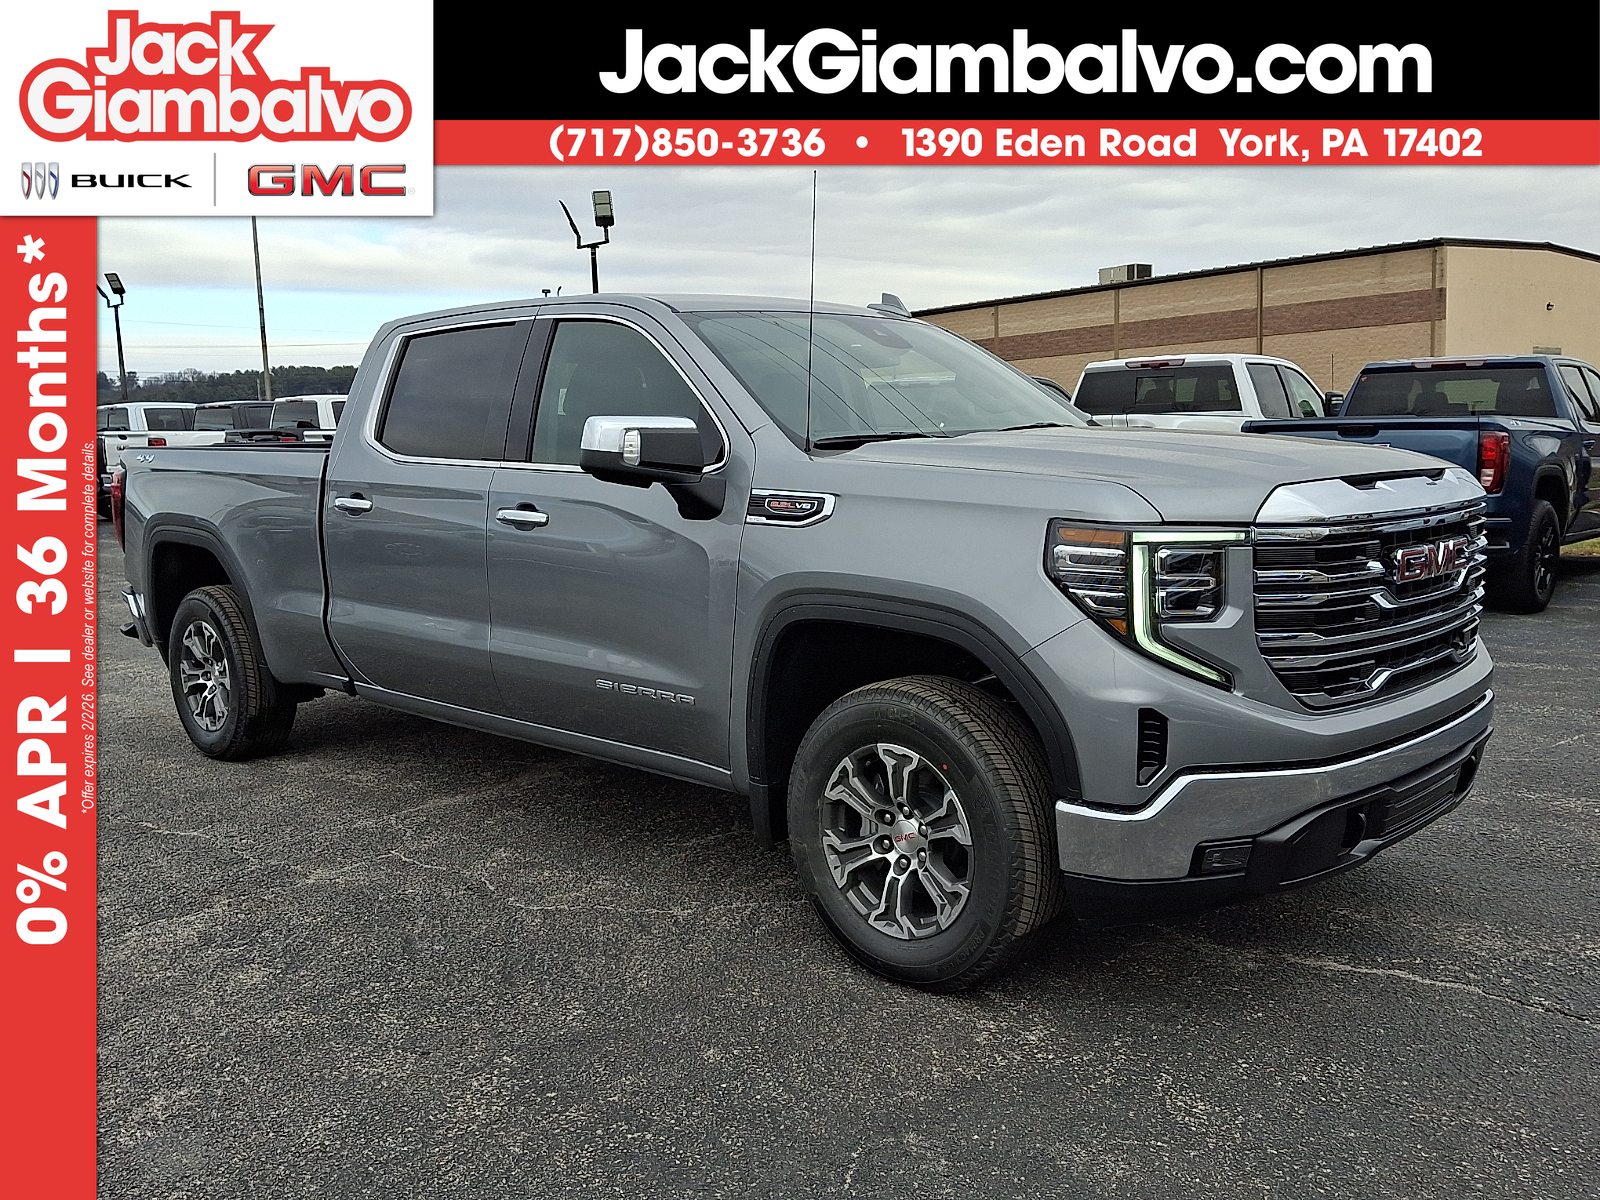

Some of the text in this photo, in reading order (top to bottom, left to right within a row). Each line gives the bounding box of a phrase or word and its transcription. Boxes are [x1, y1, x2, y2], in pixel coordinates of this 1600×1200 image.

[1396, 537, 1468, 585] GMC
[595, 678, 696, 705] SIERRA
[894, 832, 915, 842] GMC
